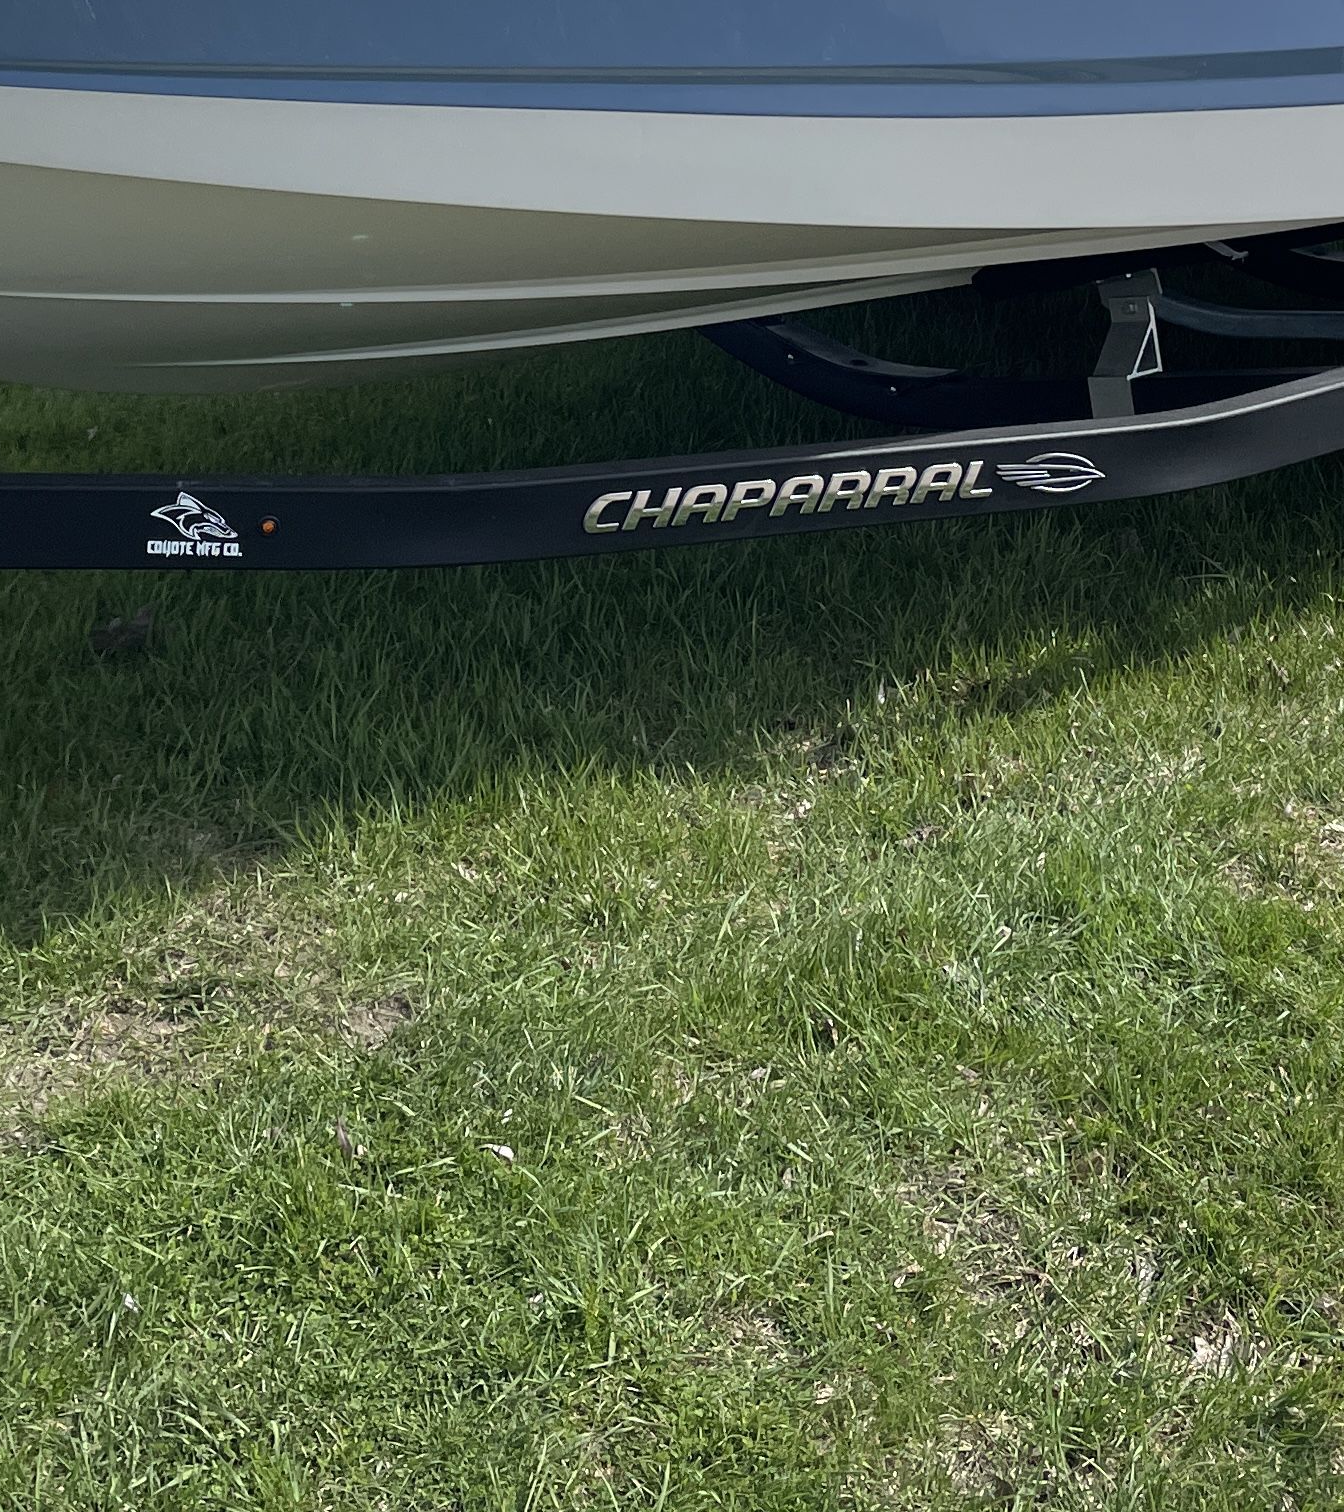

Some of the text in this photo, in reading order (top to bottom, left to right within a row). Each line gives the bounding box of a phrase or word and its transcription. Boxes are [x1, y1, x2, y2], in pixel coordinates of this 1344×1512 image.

[582, 460, 993, 535] CHAPARRAL
[146, 539, 194, 558] COYOTE
[196, 541, 222, 557] MFG
